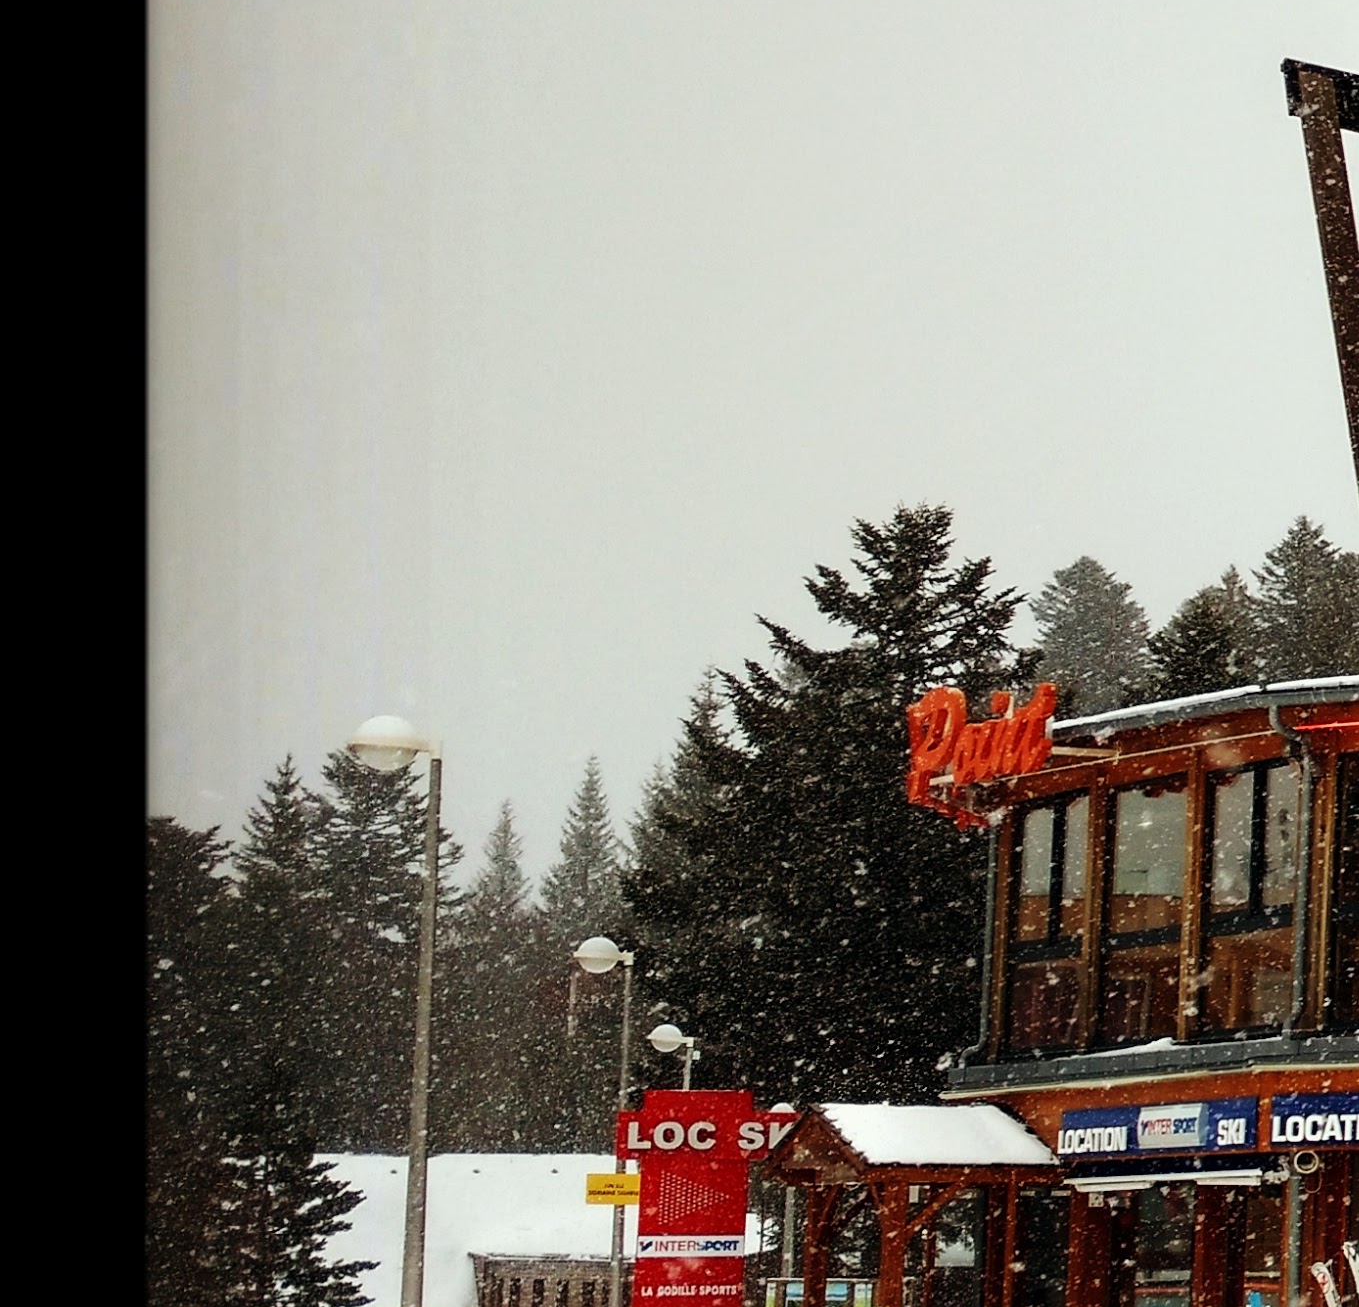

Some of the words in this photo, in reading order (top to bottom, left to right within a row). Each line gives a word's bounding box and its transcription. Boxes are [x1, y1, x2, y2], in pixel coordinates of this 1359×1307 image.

[627, 1120, 717, 1150] LOC
[737, 1120, 796, 1150] SK
[1057, 1126, 1128, 1155] LOCATION
[1216, 1118, 1247, 1147] SKI
[641, 1285, 653, 1297] LA
[699, 1284, 738, 1296] SPORTS
